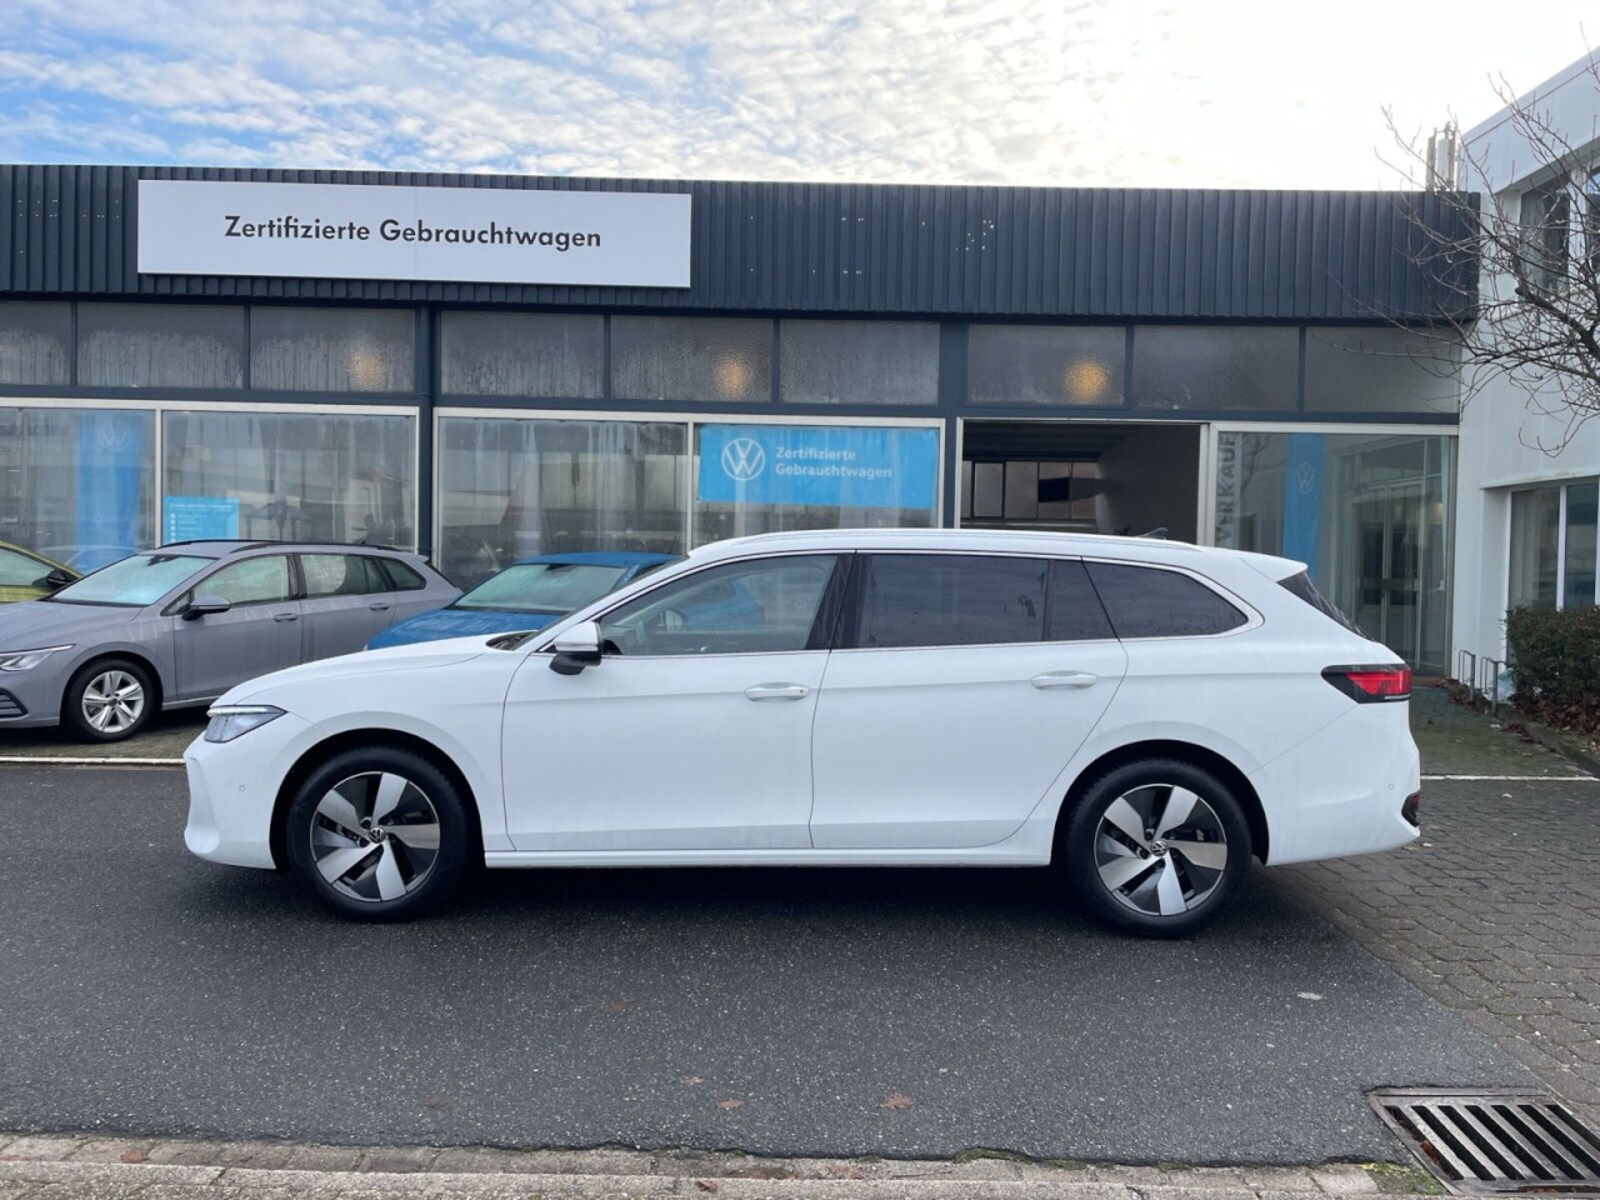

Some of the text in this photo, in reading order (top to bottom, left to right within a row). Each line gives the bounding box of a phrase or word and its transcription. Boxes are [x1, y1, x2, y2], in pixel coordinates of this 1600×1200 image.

[224, 215, 601, 252] Zertifizierte Gebrauchtwagen
[722, 438, 765, 481] VW
[776, 446, 856, 461] Zertifizierte
[776, 463, 892, 480] Gebrauchtwagen
